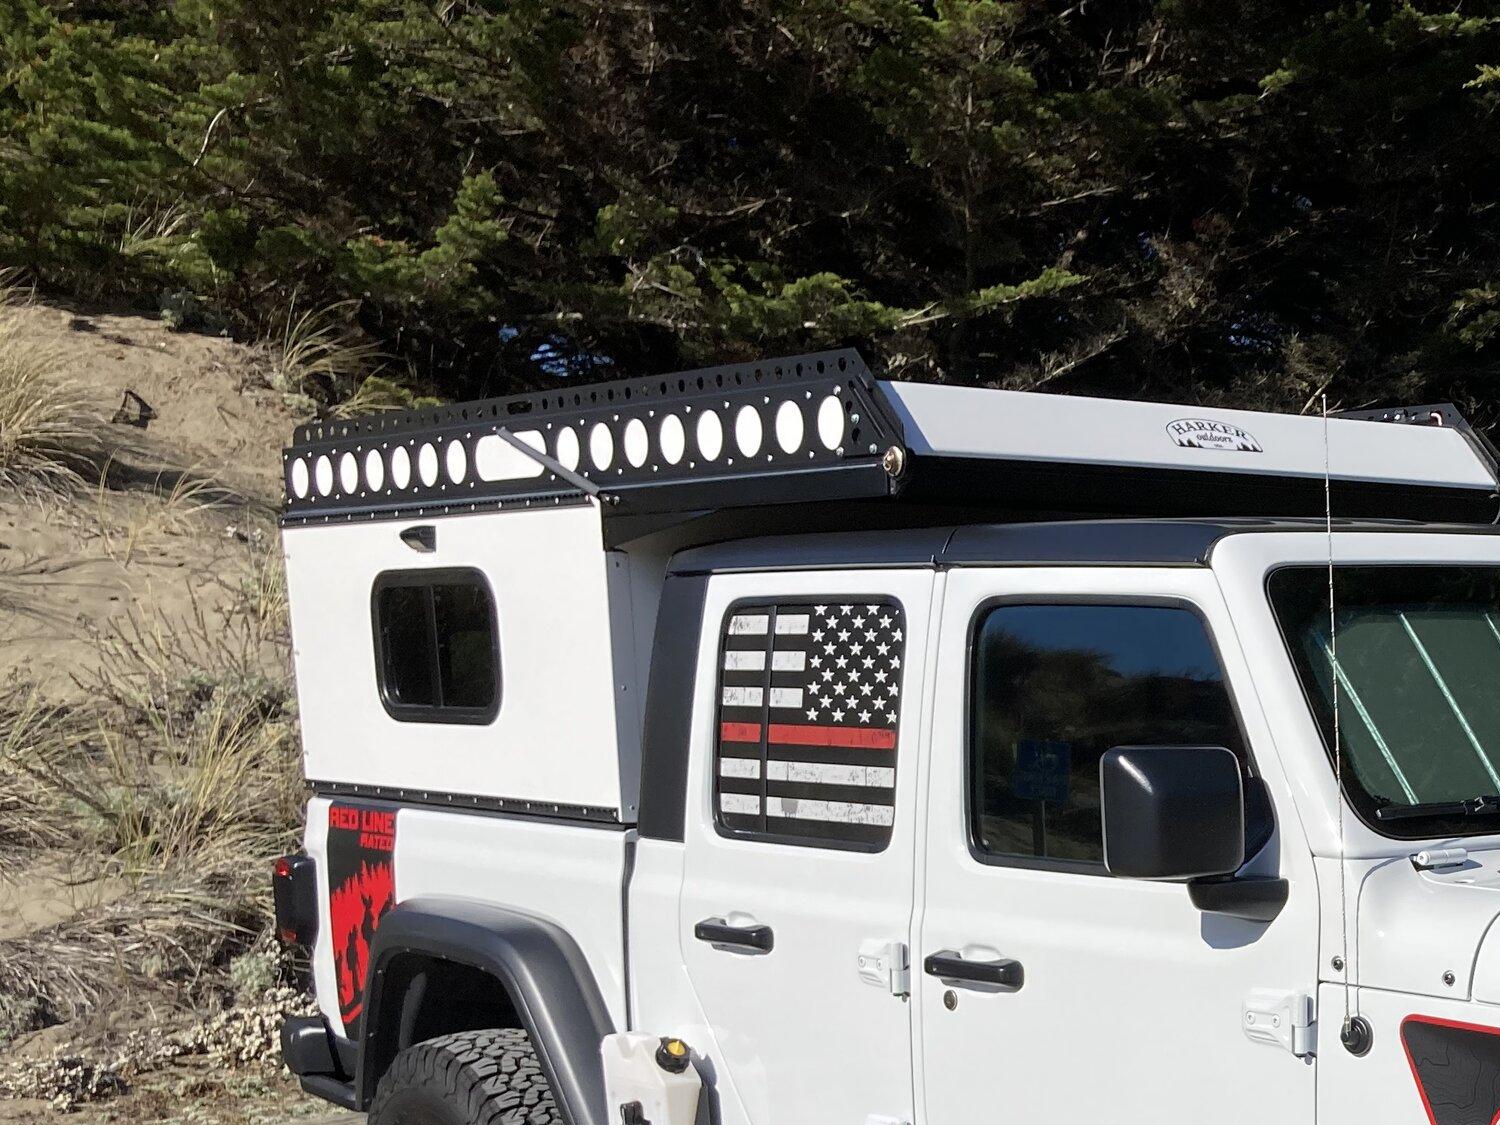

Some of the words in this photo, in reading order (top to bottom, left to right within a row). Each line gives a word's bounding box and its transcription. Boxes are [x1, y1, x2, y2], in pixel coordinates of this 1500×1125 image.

[1171, 420, 1248, 440] HARKER
[329, 807, 359, 830] RED
[362, 810, 395, 834] LINE
